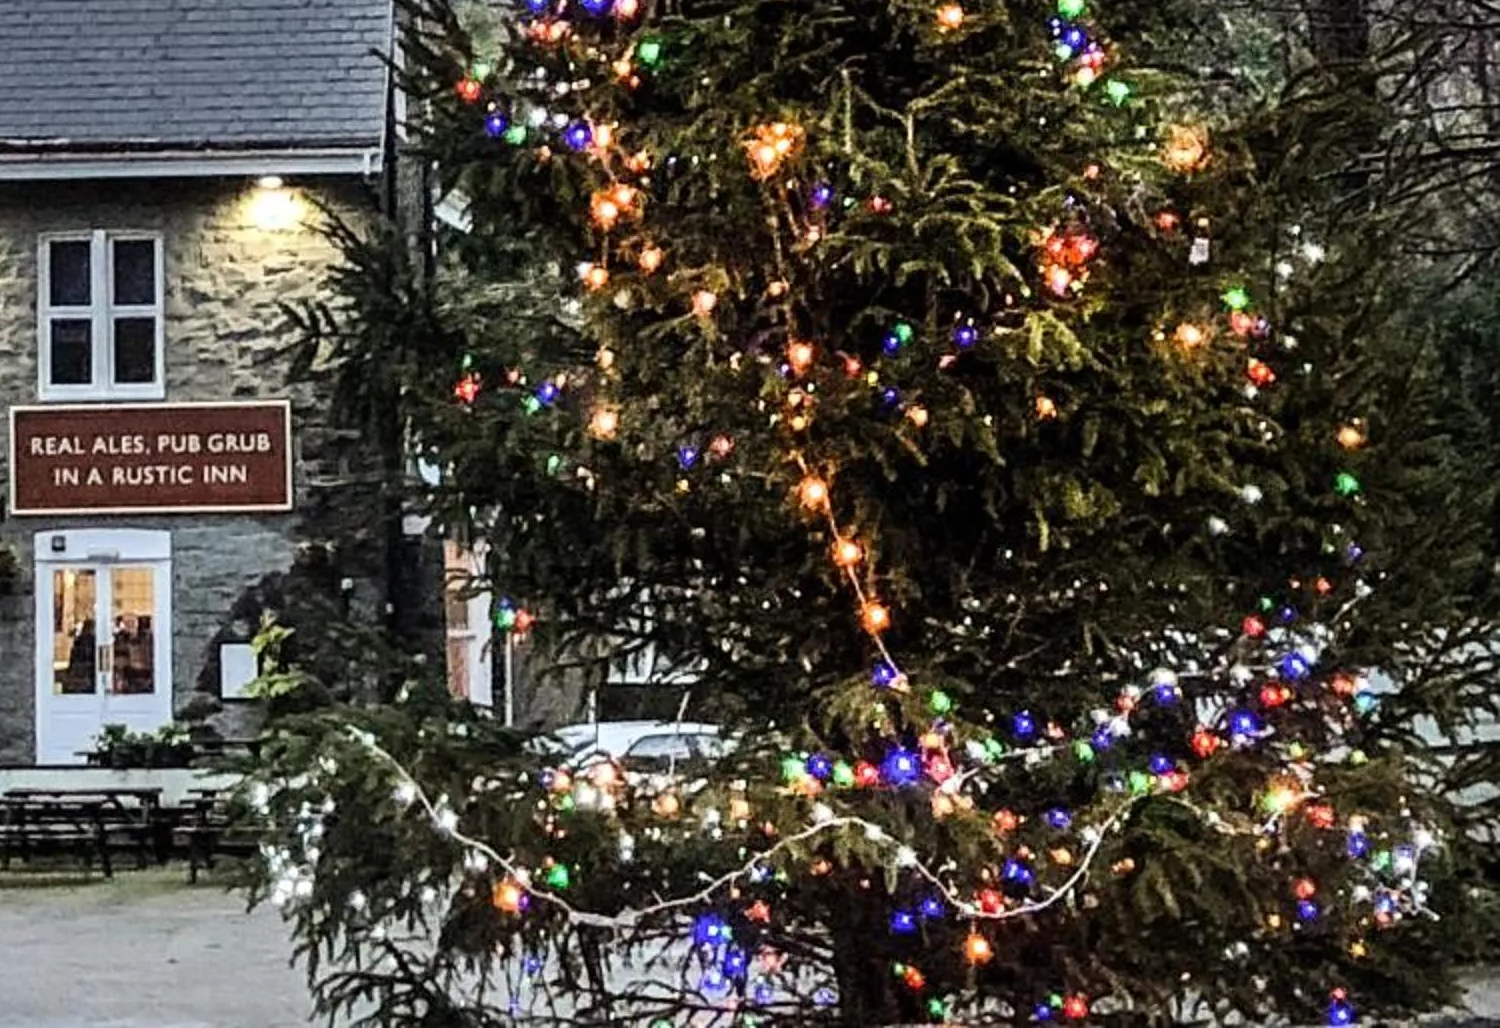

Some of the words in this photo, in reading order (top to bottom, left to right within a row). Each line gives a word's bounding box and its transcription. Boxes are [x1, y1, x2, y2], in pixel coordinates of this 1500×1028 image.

[30, 436, 85, 456] REAL
[157, 434, 201, 454] PUB
[207, 433, 271, 453] GRUB
[54, 467, 79, 486] IN
[86, 467, 102, 485] A
[112, 466, 193, 485] RUSTIC
[203, 465, 248, 484] INN
